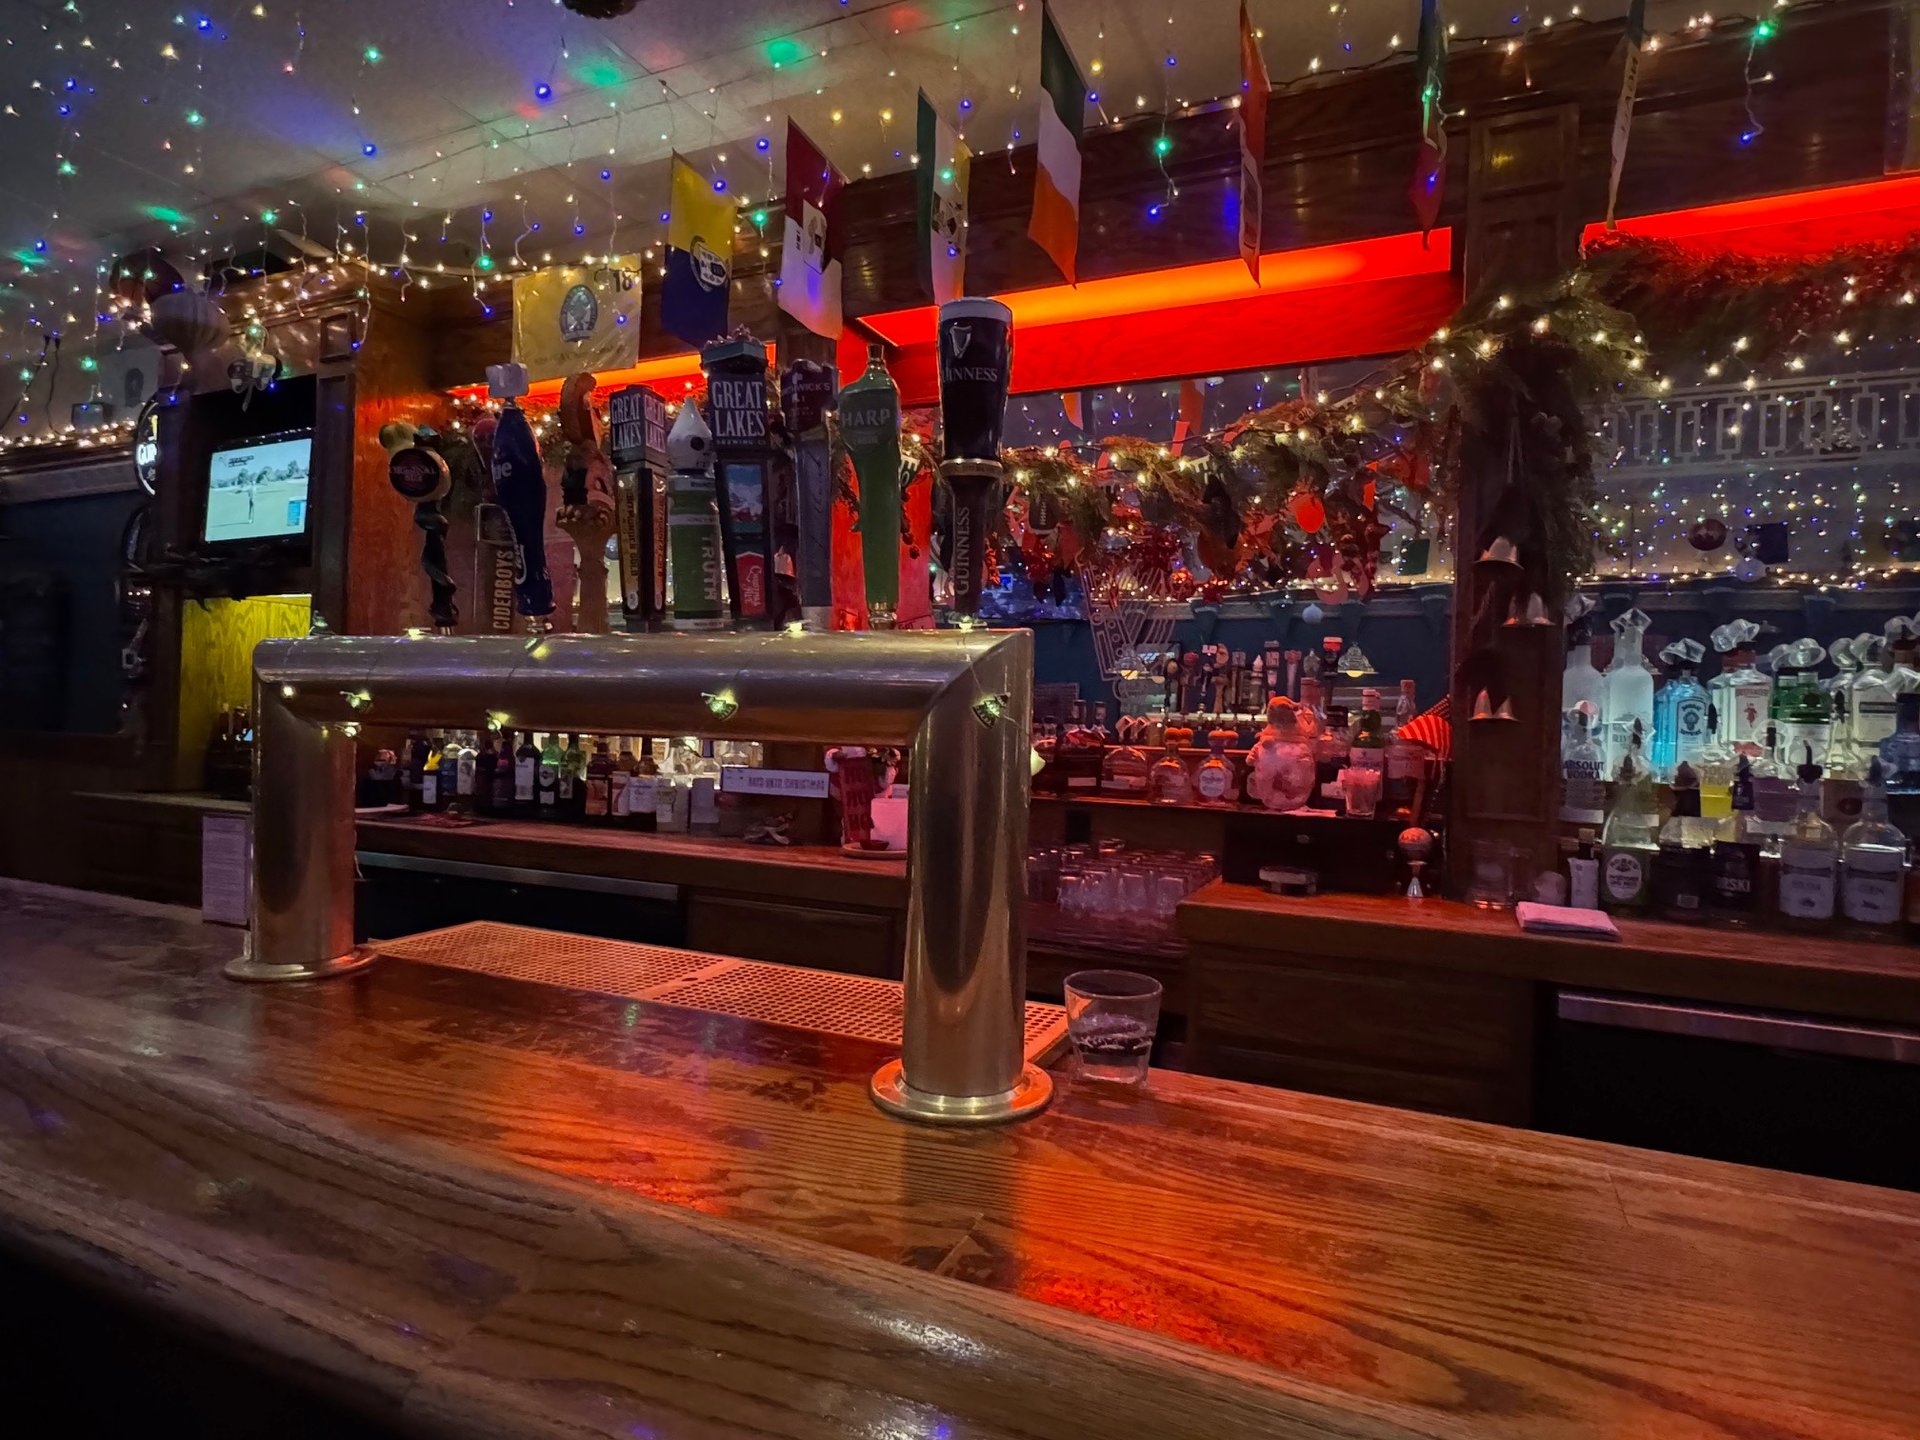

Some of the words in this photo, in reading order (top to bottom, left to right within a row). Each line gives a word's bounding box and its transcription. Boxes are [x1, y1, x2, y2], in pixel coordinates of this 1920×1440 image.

[611, 393, 641, 425] GREAT
[711, 380, 763, 409] GREAT
[714, 409, 767, 438] LAKES
[841, 408, 891, 428] HARP
[613, 421, 642, 451] LAKES
[630, 552, 640, 577] GOLD
[957, 505, 971, 596] GUINNESS
[700, 535, 719, 601] TRUTH
[492, 549, 514, 631] CIDERBOYS
[1564, 760, 1605, 770] ABSOLUT
[1566, 769, 1601, 779] VODKA
